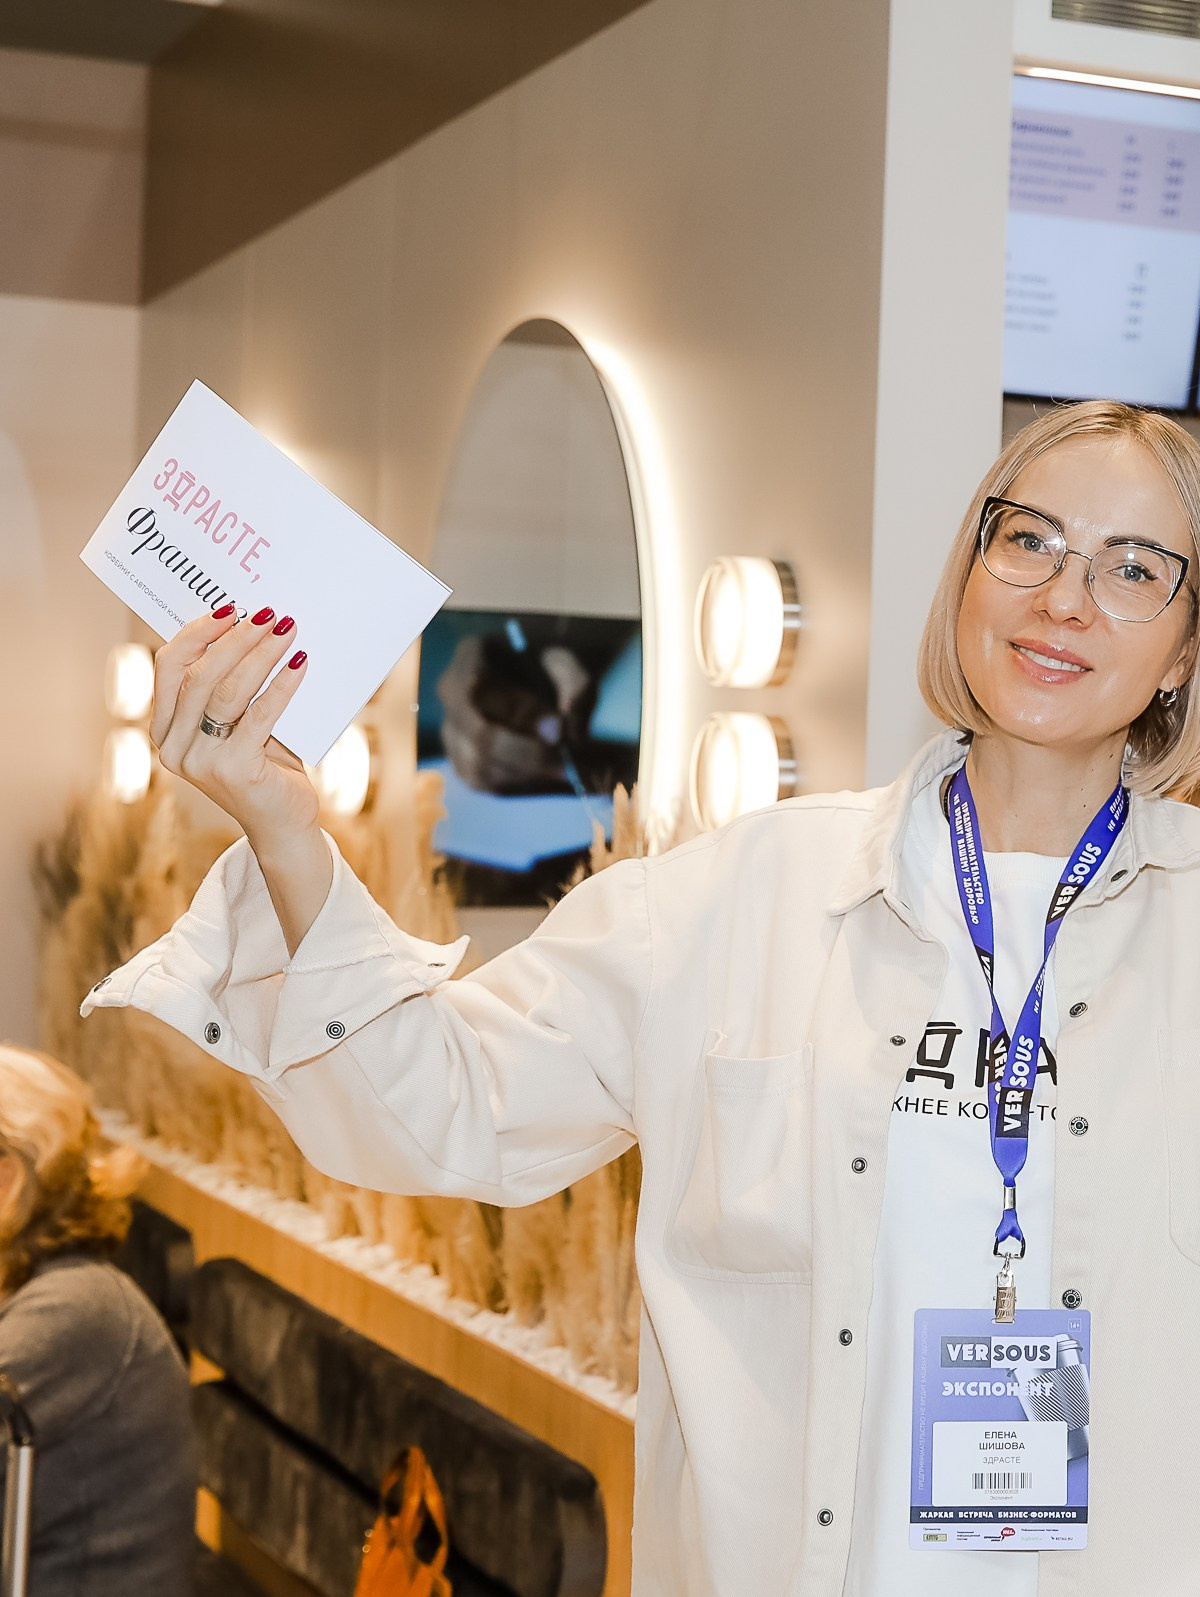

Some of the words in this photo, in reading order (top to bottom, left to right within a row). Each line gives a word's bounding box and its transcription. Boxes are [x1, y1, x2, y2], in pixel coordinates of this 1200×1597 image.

[104, 550, 131, 577] КОФЕЙНИ
[129, 573, 136, 582] С
[134, 578, 168, 611] АВТОРСКОЙ
[953, 793, 960, 809] НЕ
[954, 809, 965, 837] ВРЕДИТ
[1107, 819, 1116, 832] НЕ
[957, 838, 970, 874] ВАШЕМУ
[960, 801, 985, 905] ПРЕДПРИНИМАТЕЛЬСТВО
[962, 876, 979, 925] ЗДОРОВЬЮ
[984, 1431, 1018, 1439] ЕЛЕНА
[979, 1442, 1026, 1450] ШИШОВА
[983, 1456, 1021, 1465] ЗДРАСТЕ
[919, 1511, 954, 1519] ЖАРКАЯ
[958, 1511, 994, 1519] ВСТРЕЧА
